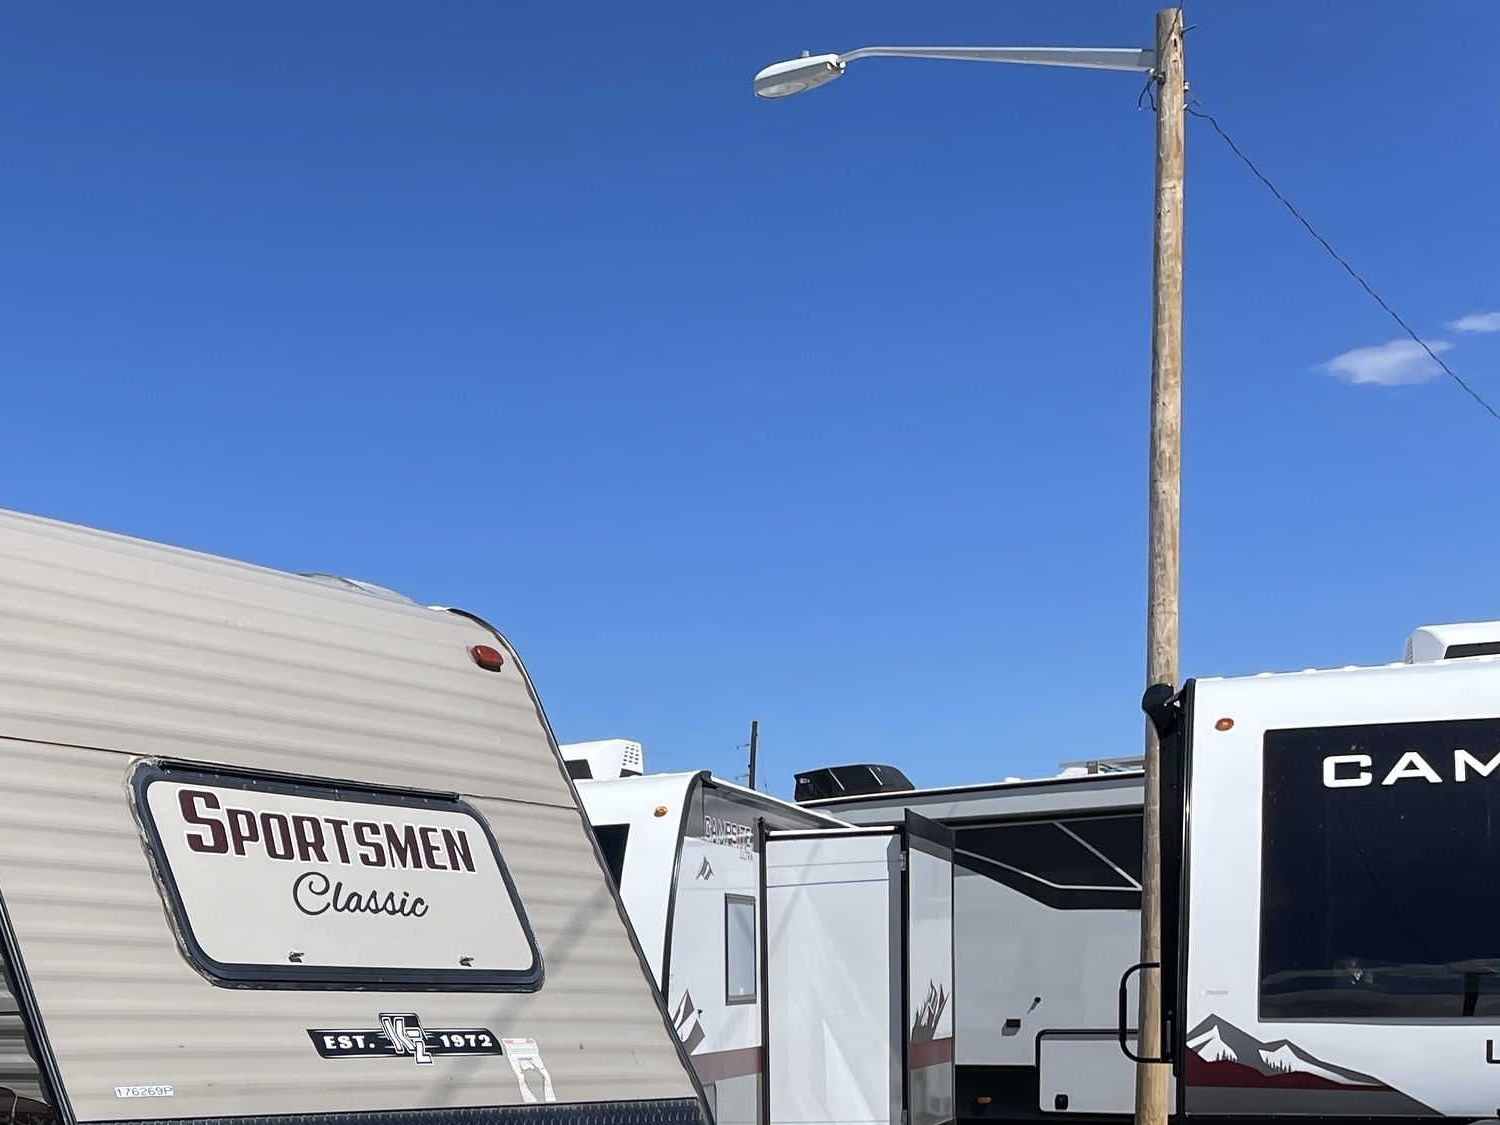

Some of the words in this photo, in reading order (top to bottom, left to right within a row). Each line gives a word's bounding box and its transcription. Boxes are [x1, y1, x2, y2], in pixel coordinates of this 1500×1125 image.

[177, 788, 477, 873] SPORTSMEN
[293, 871, 429, 916] Classic
[323, 1035, 375, 1049] EST.
[440, 1034, 493, 1047] 1972
[117, 1086, 172, 1096] 176269P
